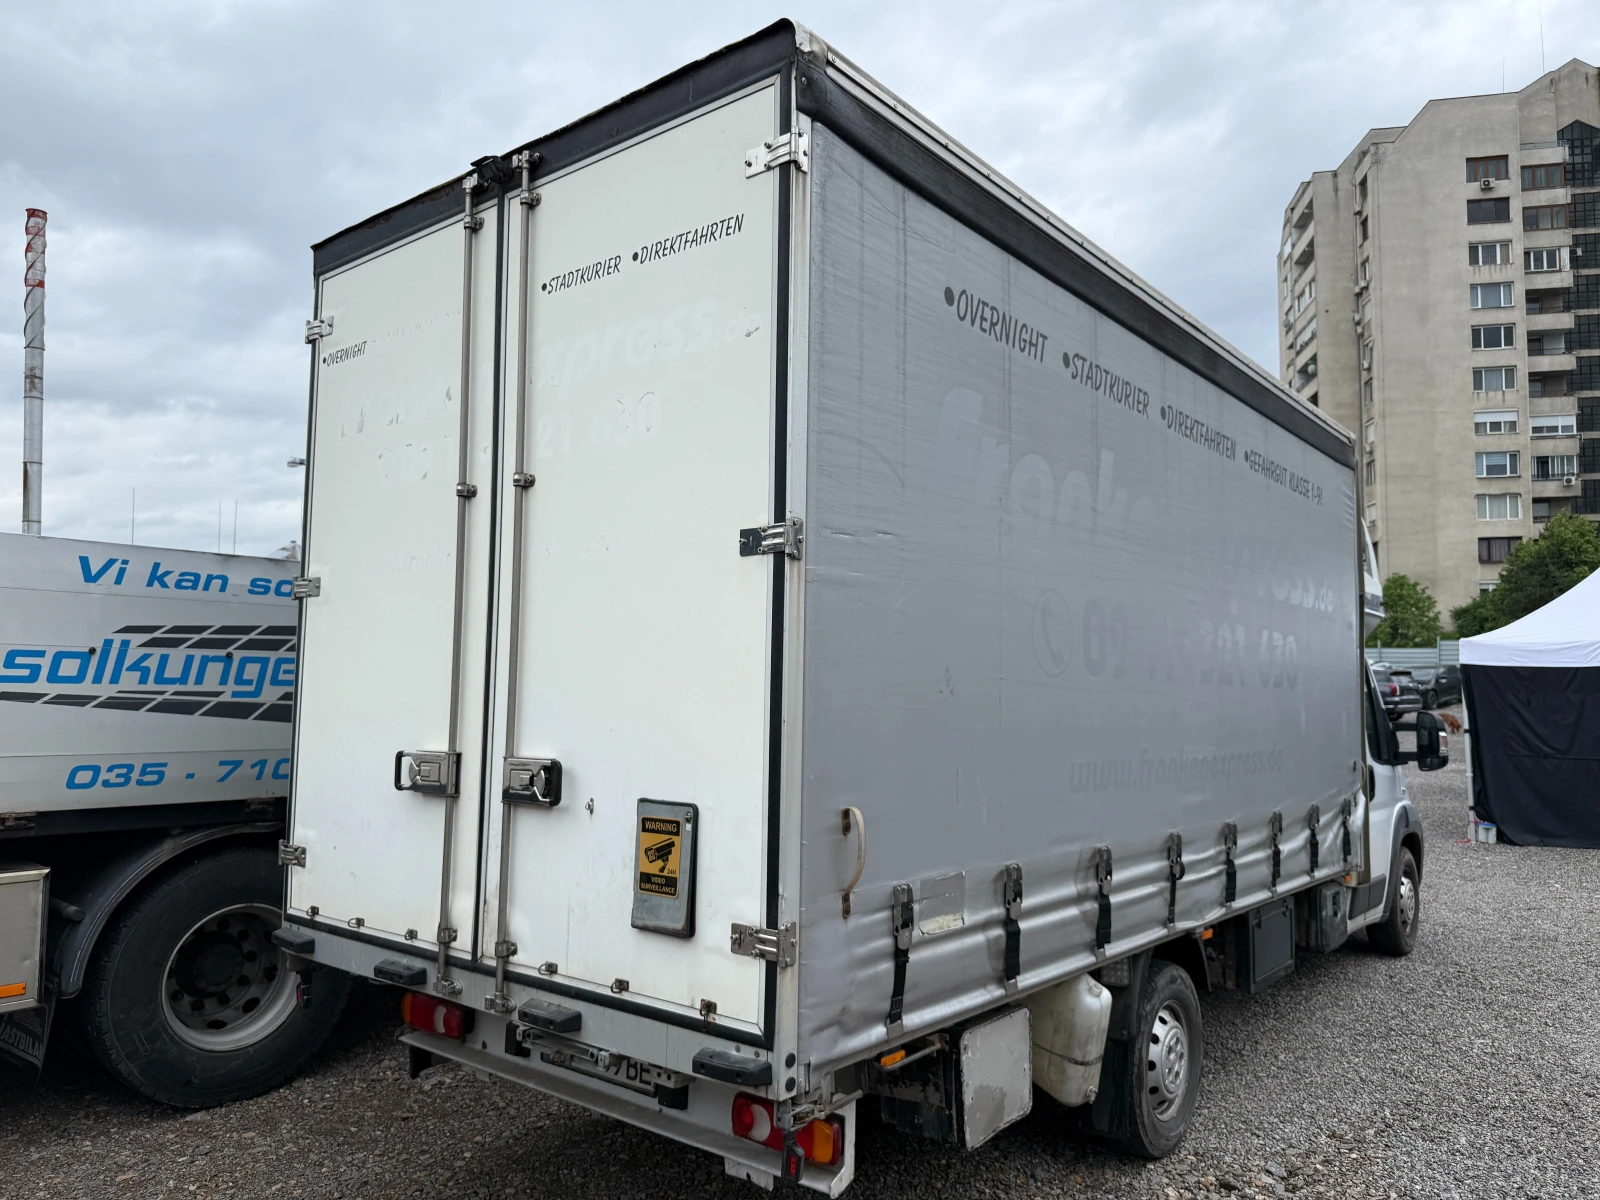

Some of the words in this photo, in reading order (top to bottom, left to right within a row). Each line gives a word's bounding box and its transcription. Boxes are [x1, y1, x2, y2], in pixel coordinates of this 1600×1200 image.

[326, 340, 368, 367] OVERNIGHT
[547, 255, 622, 294] STADTKURIER
[639, 213, 745, 265] DIREKTFAHRTEN
[956, 289, 1049, 363] OVERNIGHT
[1071, 352, 1150, 419] STADTKURIER
[1166, 405, 1237, 463] DIREKTFAHRTEN
[1248, 448, 1288, 489] GEFAHRGUT
[1288, 470, 1311, 500] KLASSE
[78, 555, 130, 585] Vi
[146, 561, 230, 593] kan
[65, 761, 168, 791] 035
[645, 820, 678, 833] WARNING
[650, 876, 666, 884] VIDEO
[667, 868, 677, 876] 24H
[640, 883, 675, 894] SURVEILLANCE
